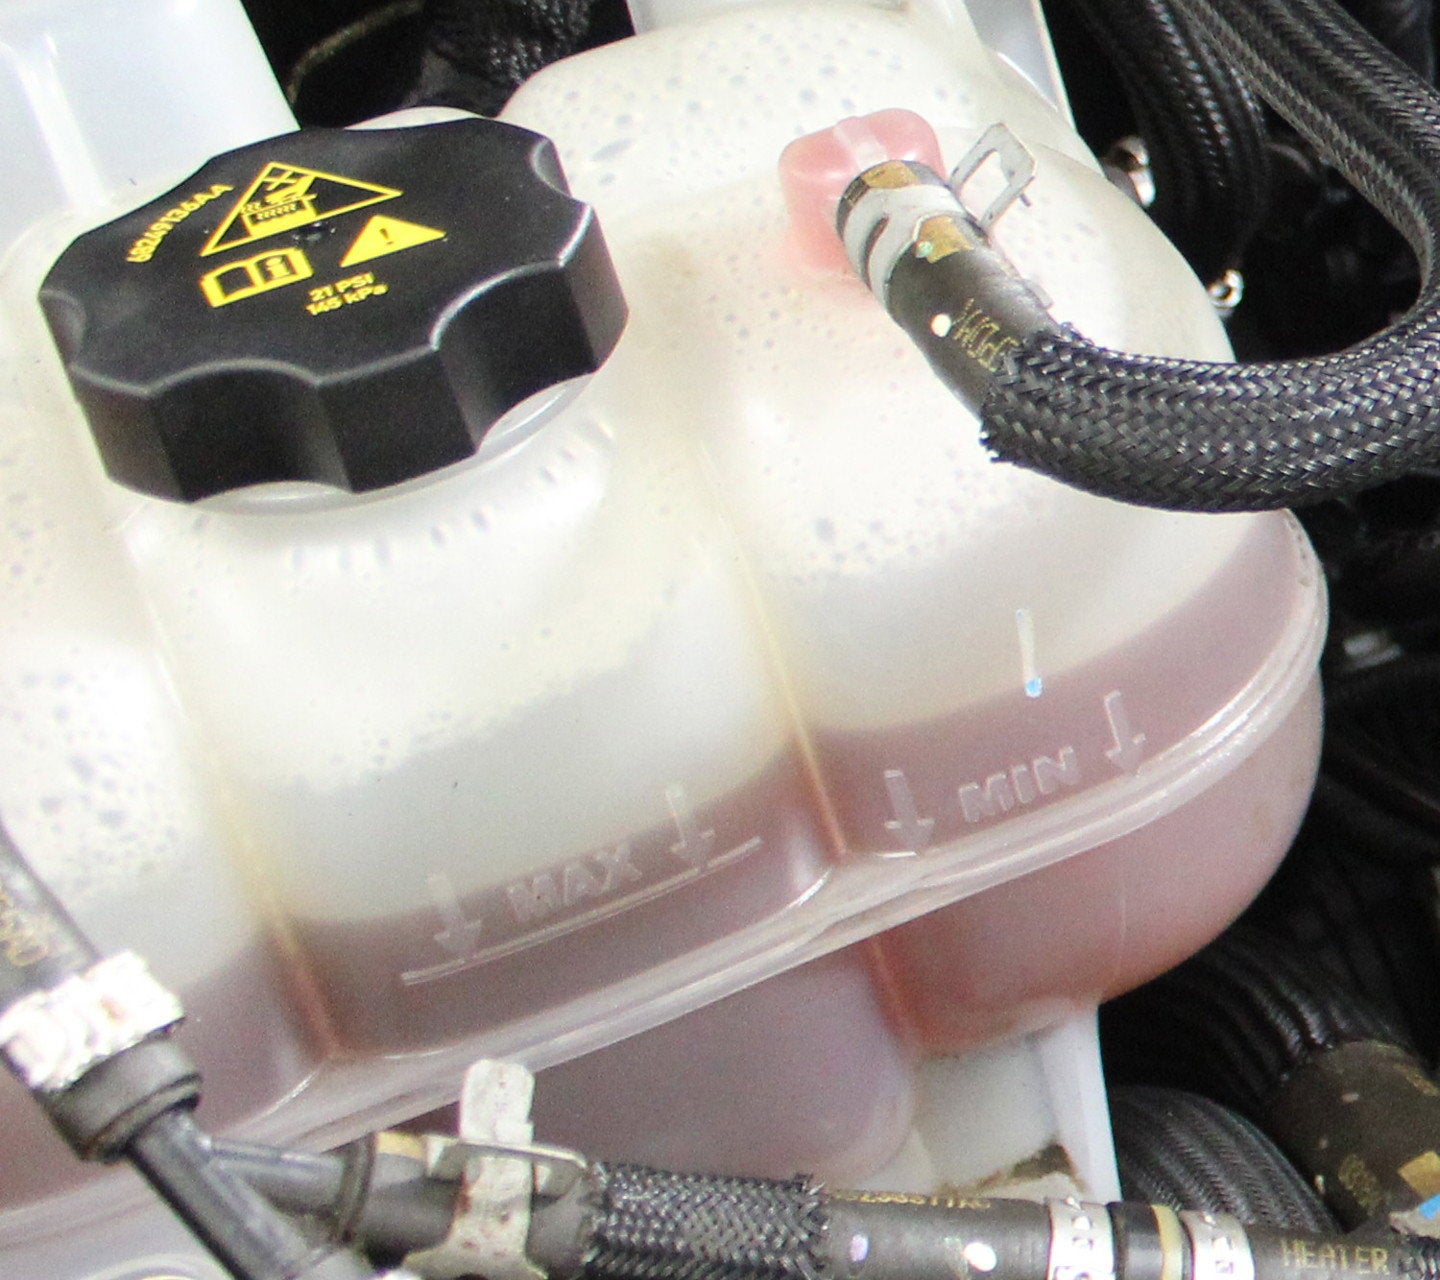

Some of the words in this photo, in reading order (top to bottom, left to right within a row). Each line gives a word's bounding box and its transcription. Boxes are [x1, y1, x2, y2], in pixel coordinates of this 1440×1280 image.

[305, 292, 344, 317] 145
[342, 282, 390, 308] kPa
[308, 282, 333, 302] 21
[333, 271, 376, 296] PSI
[957, 744, 1079, 822] MIN
[507, 842, 643, 920] MAX
[1279, 1237, 1391, 1277] HEATER
